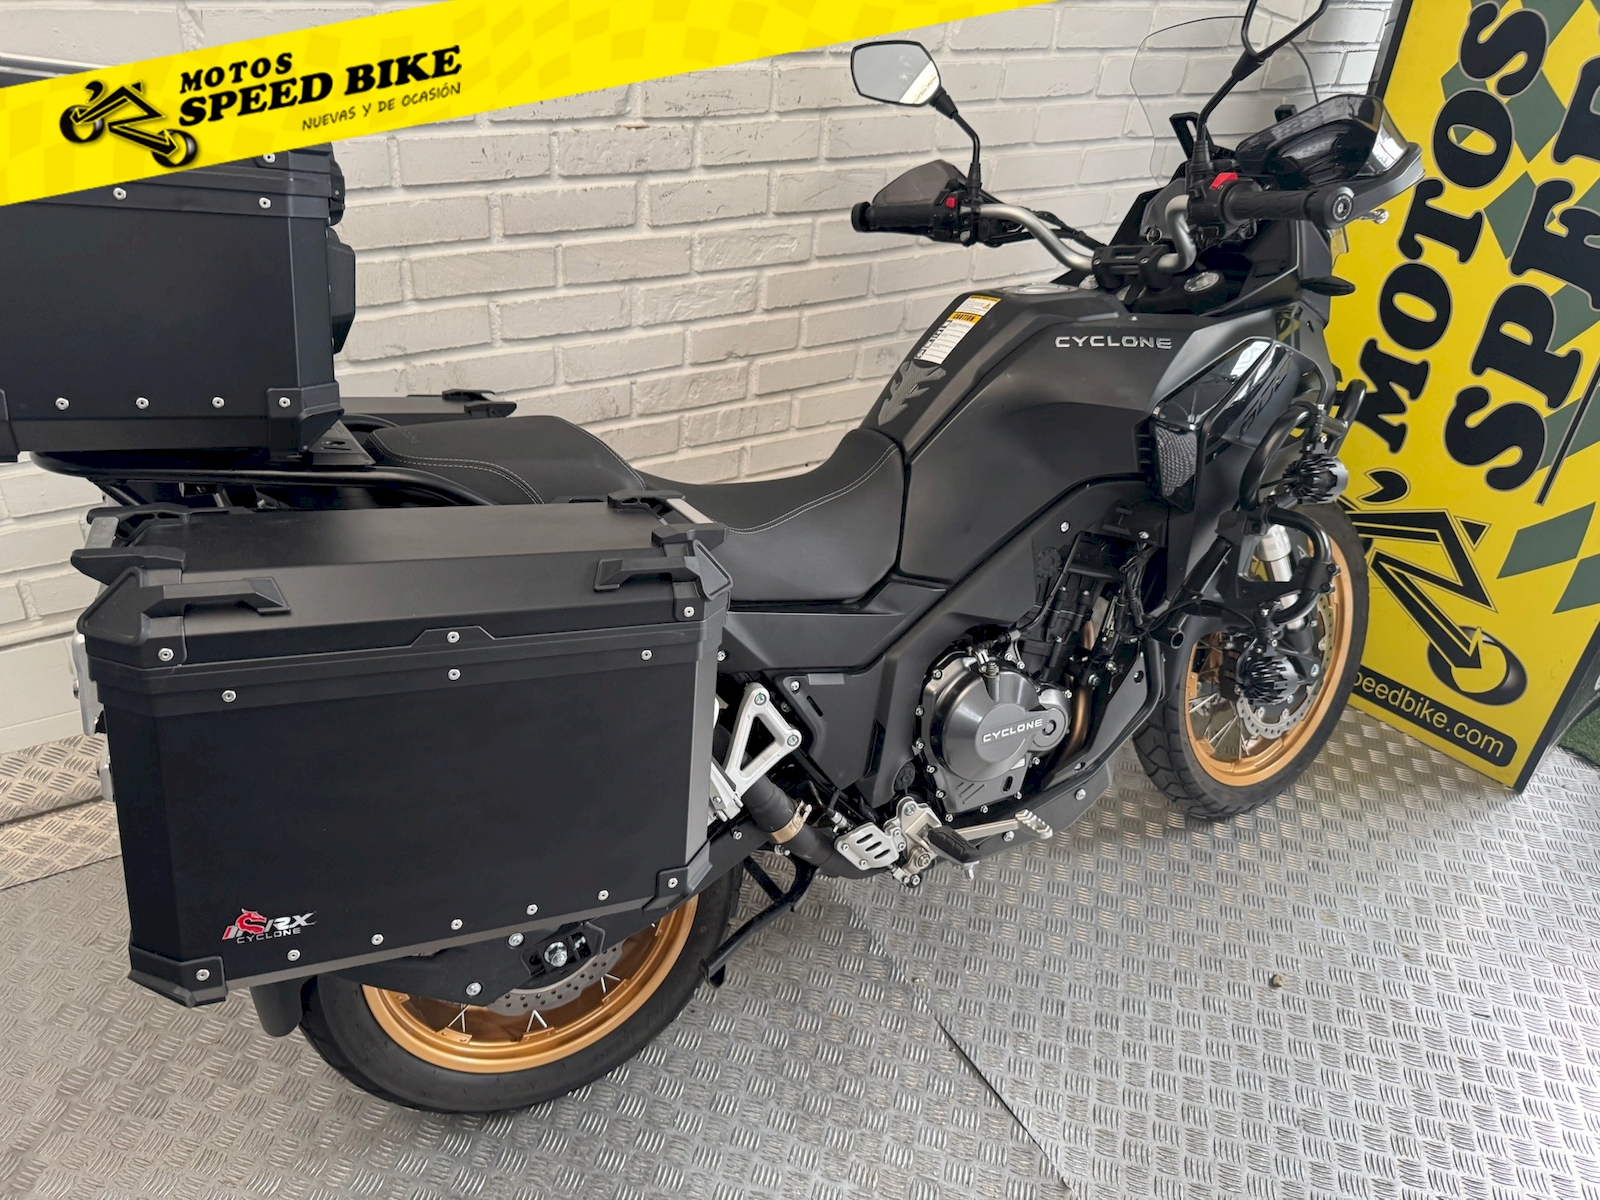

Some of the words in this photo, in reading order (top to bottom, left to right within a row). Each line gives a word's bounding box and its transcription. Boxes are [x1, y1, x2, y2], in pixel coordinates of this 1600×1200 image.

[1358, 1, 1548, 454] MOTOS
[1055, 334, 1173, 350] CYCLONE
[982, 717, 1043, 743] CYCLONE
[236, 927, 301, 944] CYCLONE
